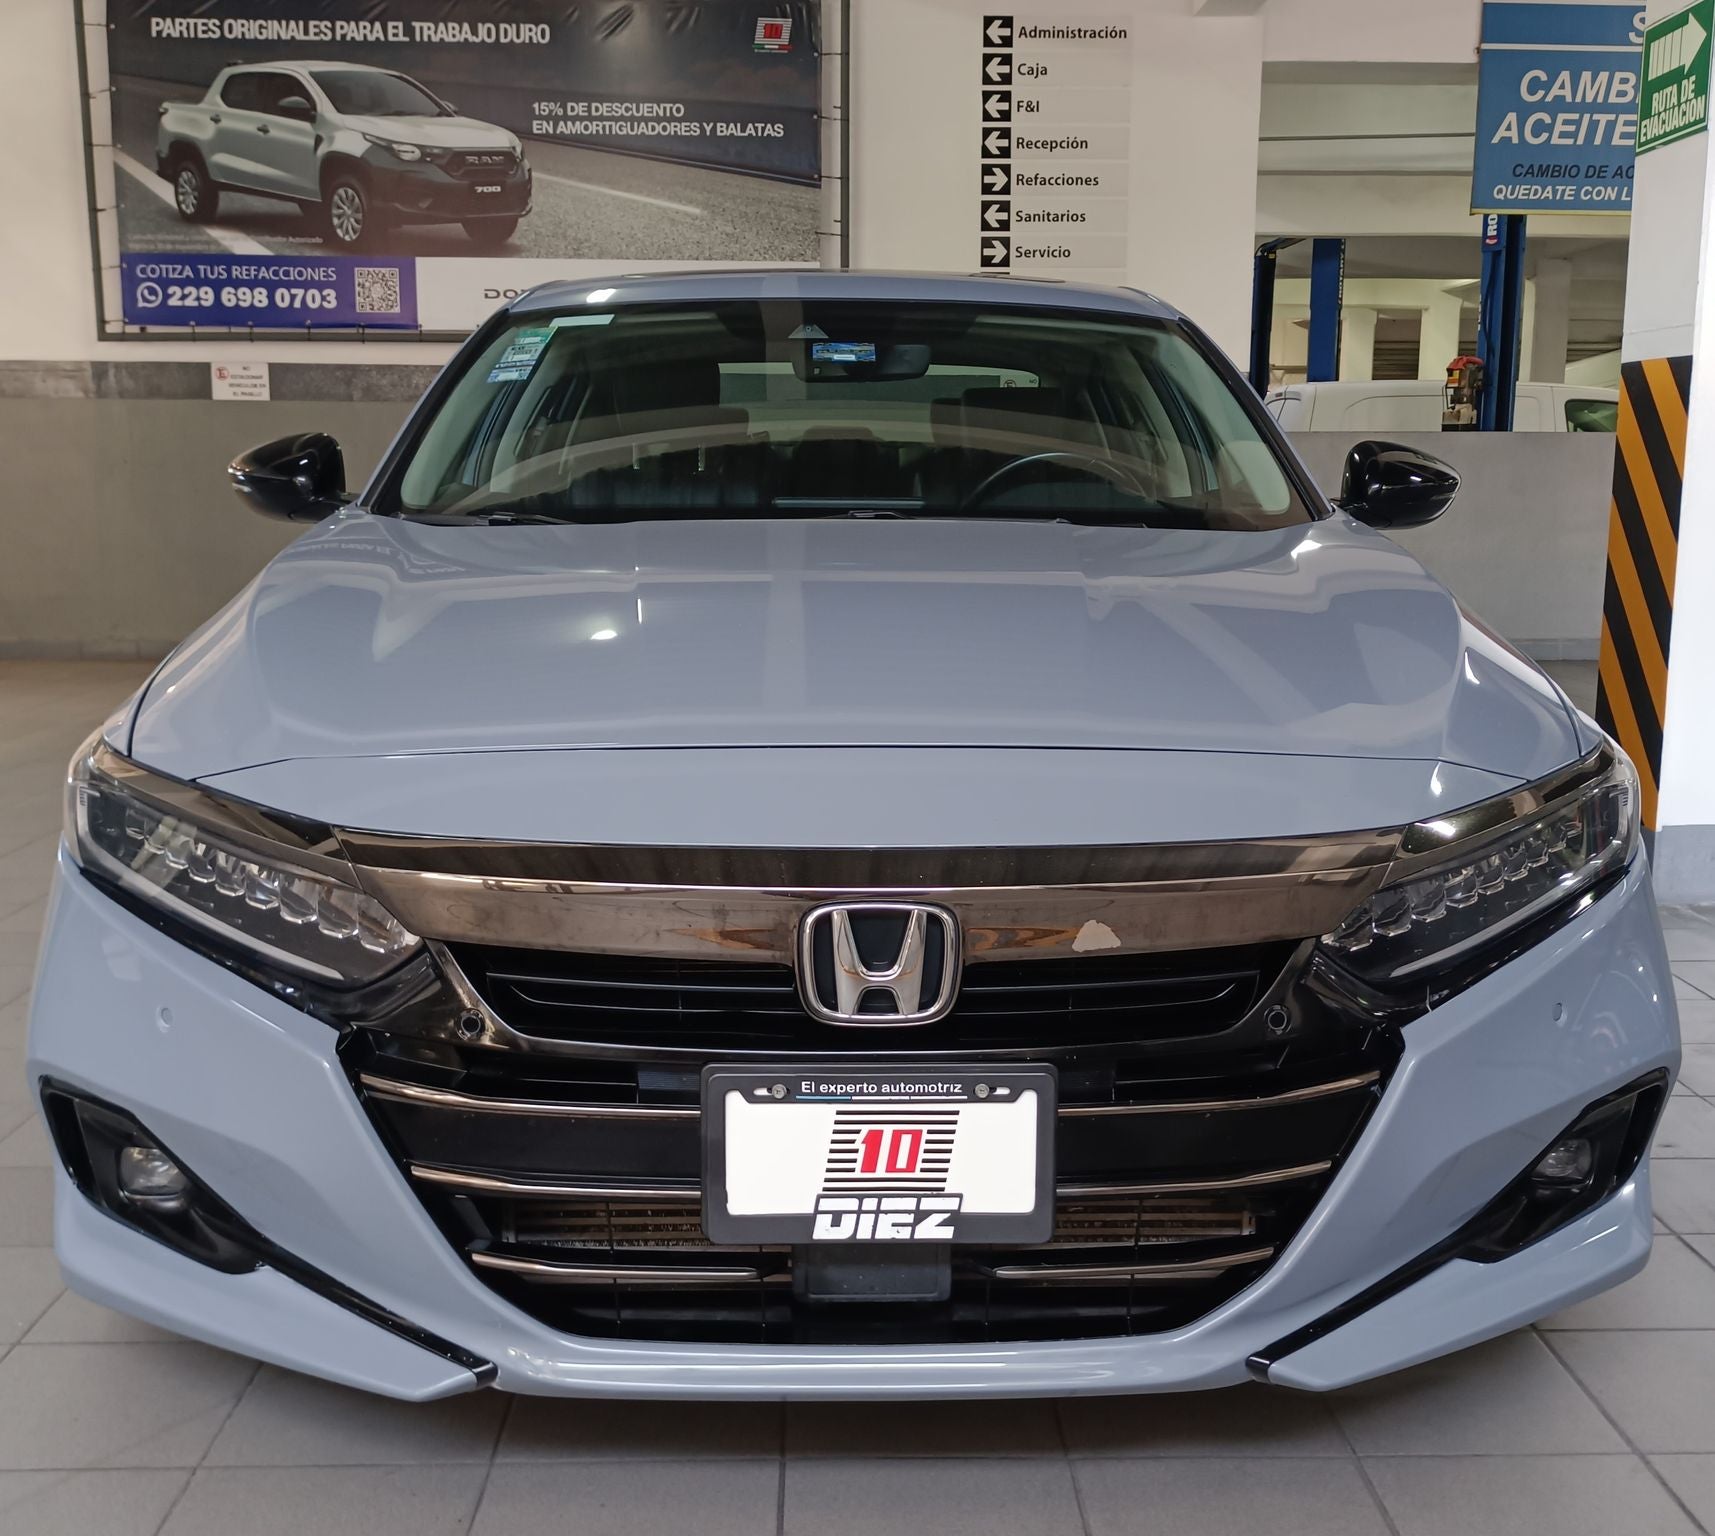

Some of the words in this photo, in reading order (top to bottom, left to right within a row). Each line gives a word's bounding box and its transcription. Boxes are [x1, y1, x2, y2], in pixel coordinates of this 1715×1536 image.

[151, 17, 221, 38] PARTES
[223, 19, 332, 41] ORIGINALES
[335, 20, 385, 41] PARA
[387, 21, 410, 41] EL
[411, 21, 496, 43] TRABAJO
[500, 23, 550, 44] DURO
[1018, 26, 1128, 40] Administración
[1017, 63, 1048, 79] Caja
[1519, 69, 1639, 104] CAMB
[1651, 83, 1678, 116] RUTA
[1680, 74, 1696, 104] DE
[532, 102, 563, 116] 15%
[567, 103, 588, 116] DE
[591, 103, 684, 117] DESCUENTO
[1016, 100, 1040, 113] F&I
[1640, 94, 1706, 143] EVACUACION
[532, 120, 554, 135] EN
[556, 121, 700, 136] AMORTIGUADORES
[703, 122, 714, 136] Y
[717, 122, 784, 137] BALATAS
[1490, 112, 1638, 146] ACEITE
[1016, 136, 1088, 152] Recepción
[1512, 163, 1580, 179] CAMBIO
[1584, 164, 1608, 179] DE
[1016, 173, 1099, 187] Refacciones
[1493, 184, 1577, 200] QUEDATE
[1580, 185, 1618, 201] CON
[1015, 209, 1086, 223] Sanitarios
[1015, 245, 1071, 259] Servicio
[136, 264, 194, 279] COTIZA
[198, 265, 228, 280] TUS
[232, 266, 337, 281] REFACCIONES
[167, 285, 215, 307] 229
[220, 286, 269, 308] 698
[274, 287, 338, 309] 0703
[484, 288, 529, 300] DO
[801, 1081, 815, 1094] El
[819, 1082, 878, 1098] experto
[881, 1082, 963, 1094] automotriz
[860, 1129, 923, 1174] 10
[812, 1196, 961, 1240] DIEZ
